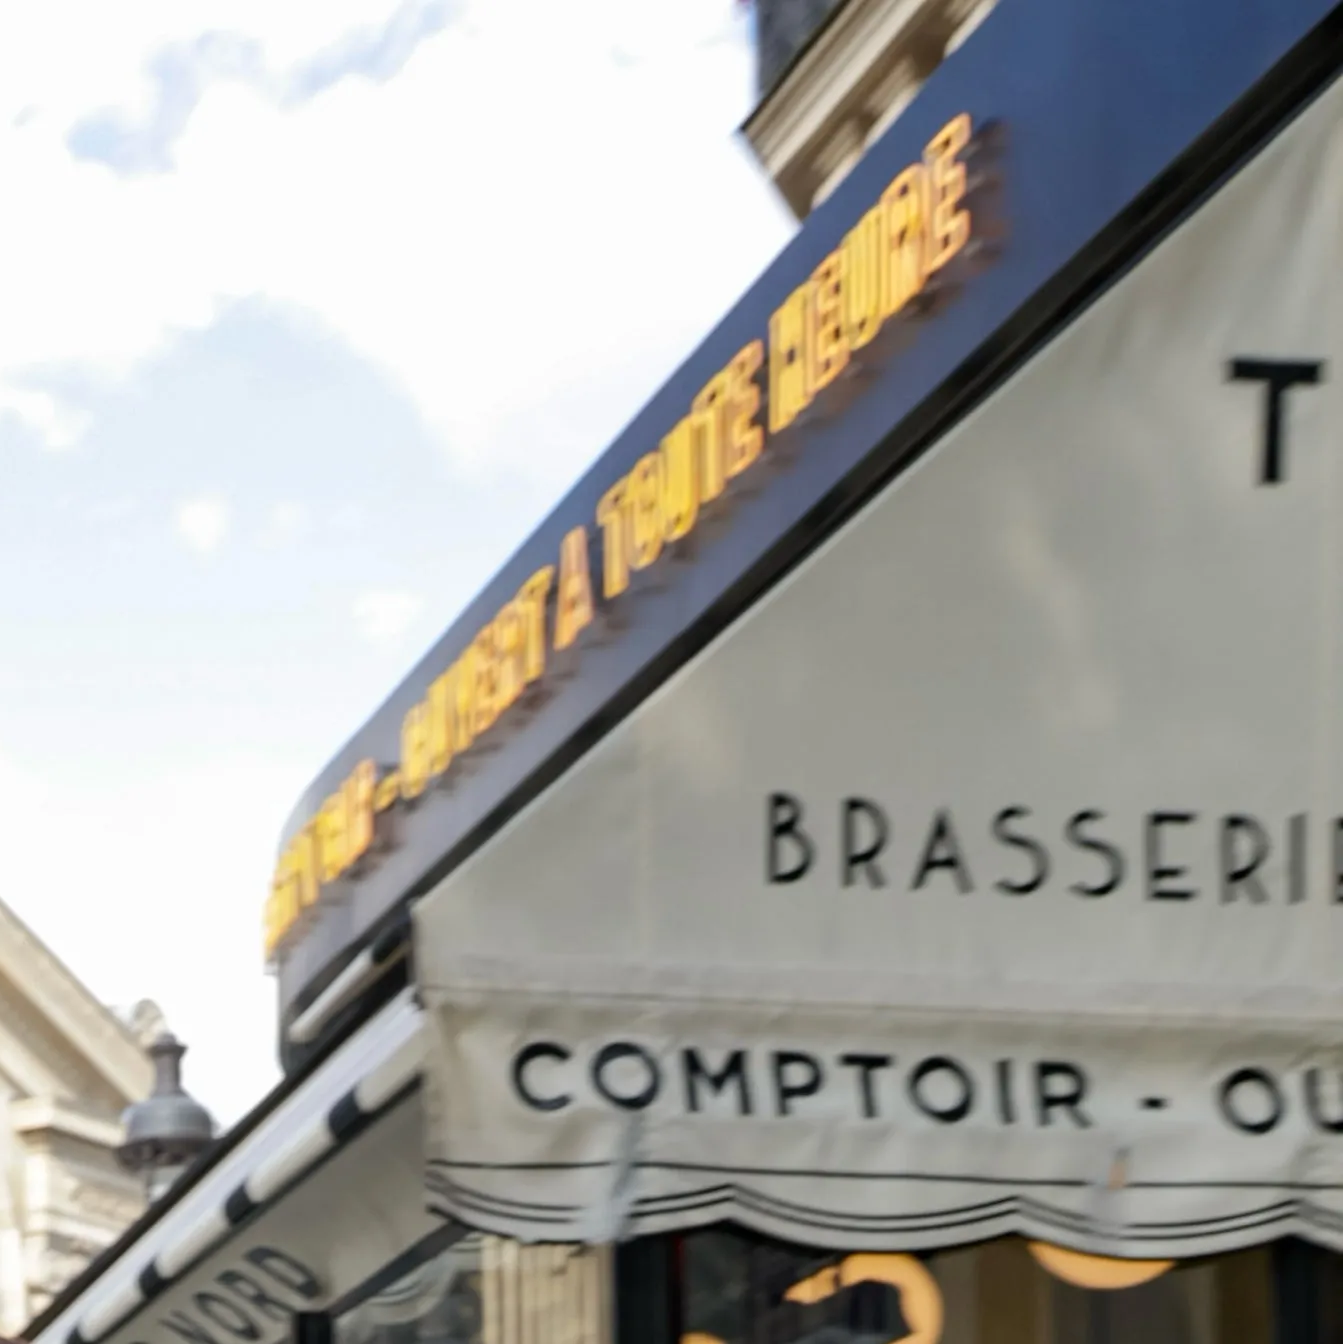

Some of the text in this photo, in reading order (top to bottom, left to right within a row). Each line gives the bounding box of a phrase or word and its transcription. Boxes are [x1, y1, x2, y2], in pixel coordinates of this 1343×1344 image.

[595, 339, 764, 600] TOUTE
[767, 112, 972, 435] HEURE
[763, 791, 1343, 907] BRASSERI
[508, 1038, 1093, 1130] COMPTOIR
